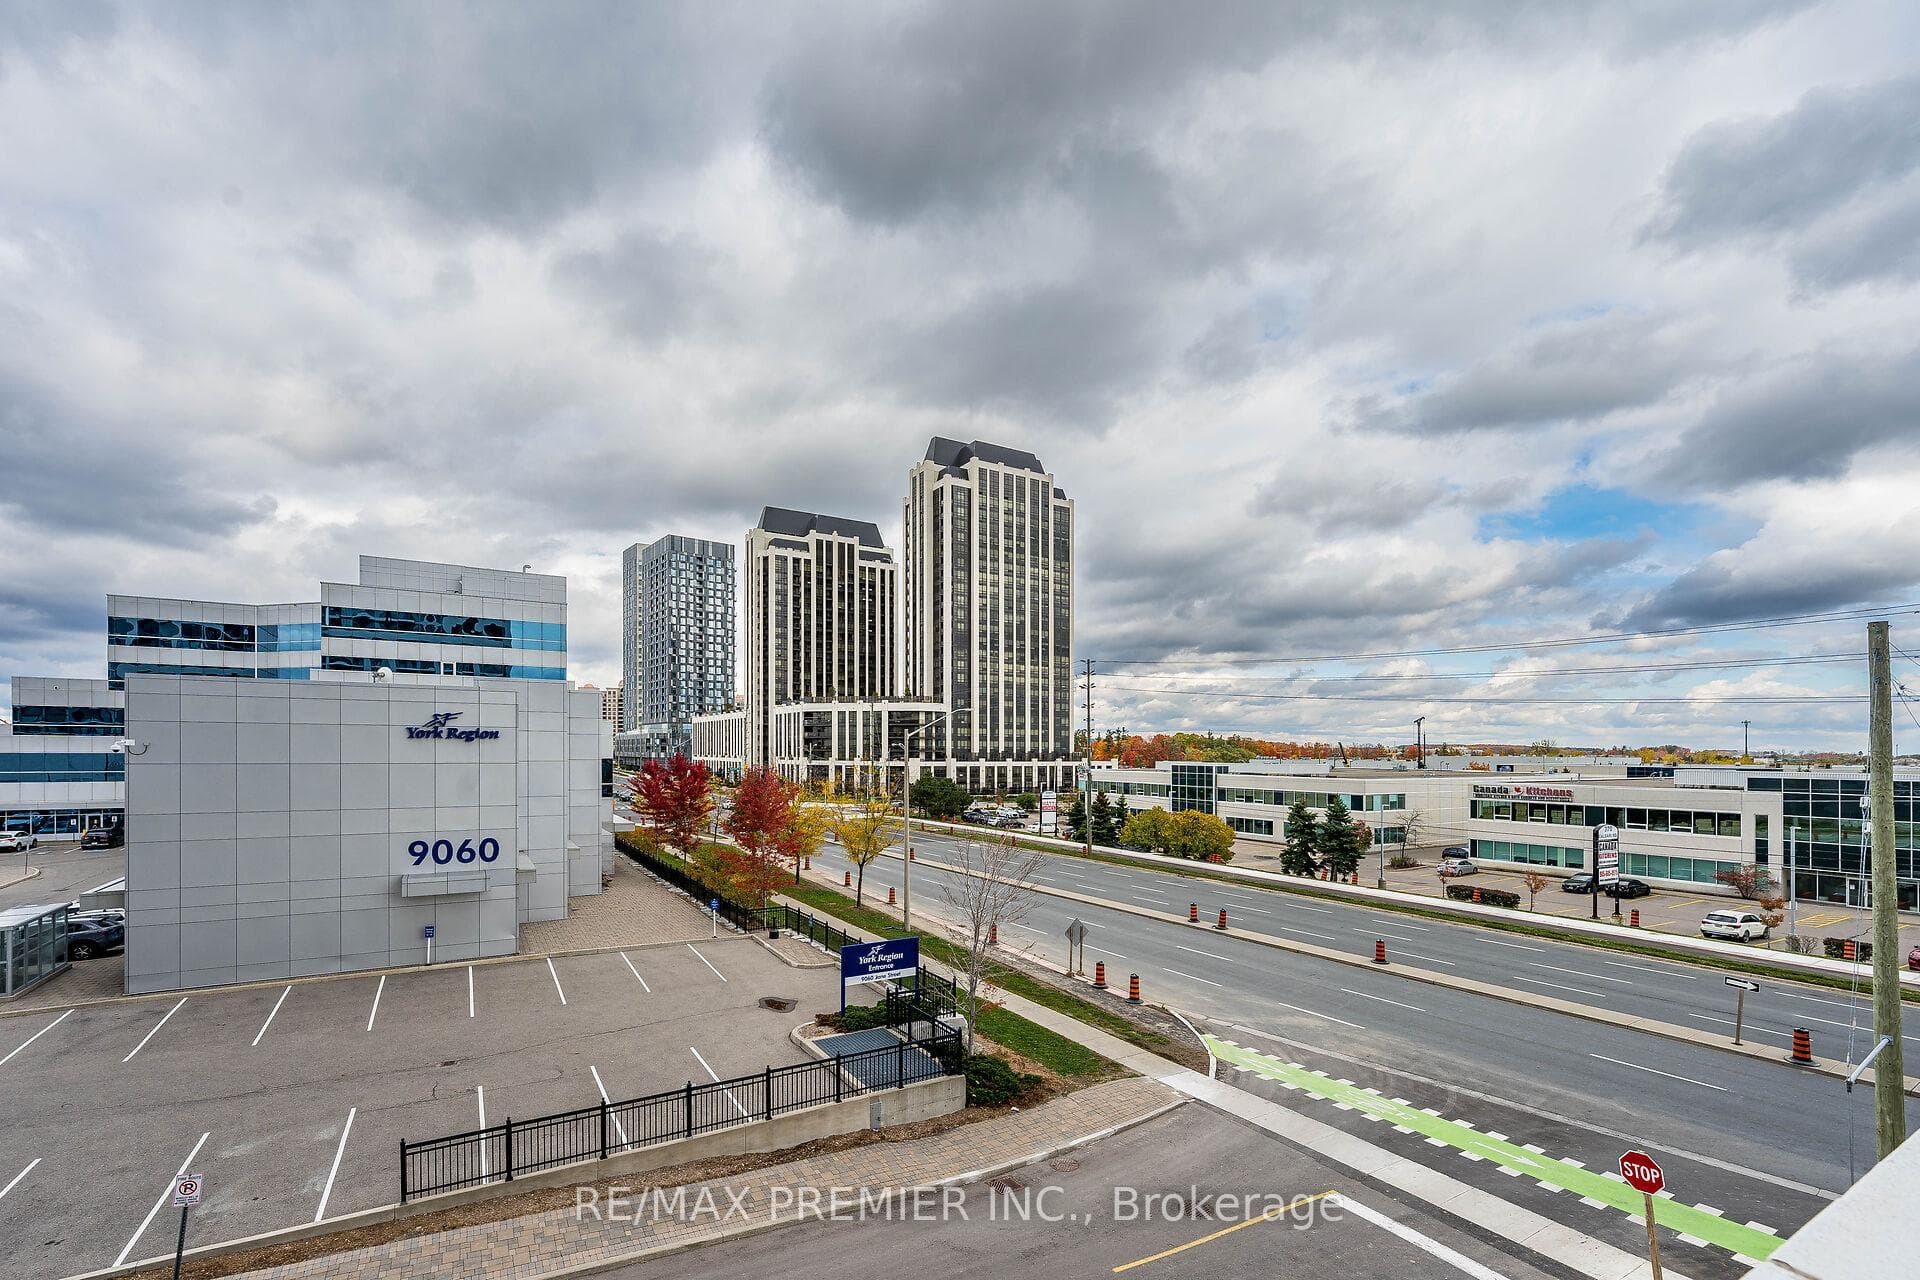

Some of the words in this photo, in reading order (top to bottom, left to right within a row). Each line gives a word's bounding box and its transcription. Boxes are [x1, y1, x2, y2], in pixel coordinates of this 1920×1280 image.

[406, 726, 443, 739] York
[445, 728, 499, 742] Region
[1473, 784, 1509, 794] Canada
[1526, 786, 1574, 797] Kitchens
[408, 838, 499, 865] 9060
[1599, 841, 1617, 851] CANADA
[859, 954, 877, 964] York
[878, 952, 904, 962] Region
[868, 963, 894, 971] Entrance
[1624, 1162, 1660, 1183] STOP
